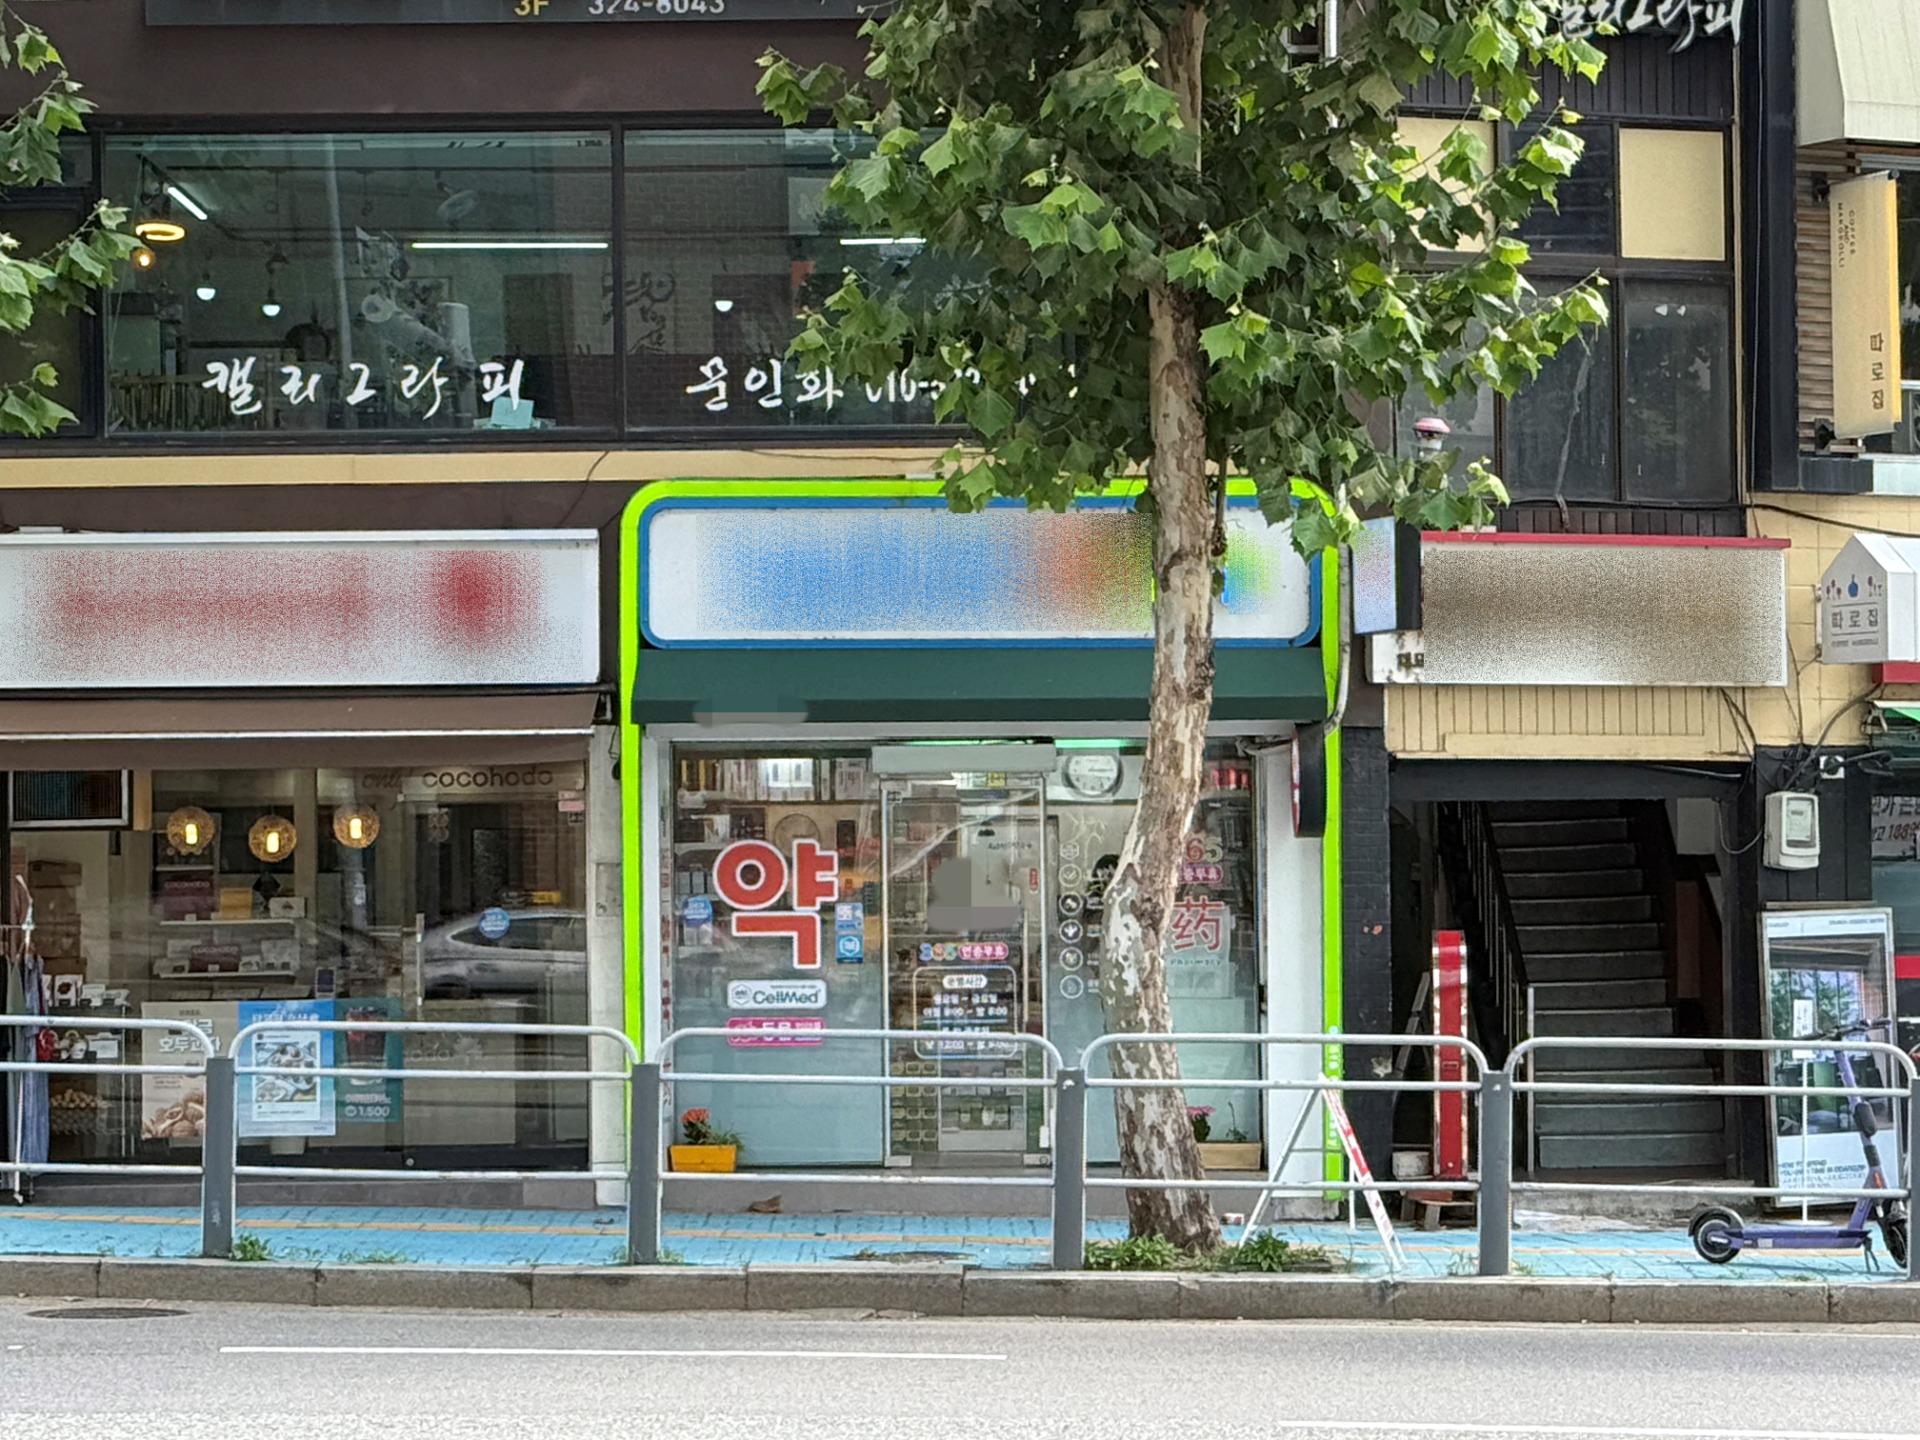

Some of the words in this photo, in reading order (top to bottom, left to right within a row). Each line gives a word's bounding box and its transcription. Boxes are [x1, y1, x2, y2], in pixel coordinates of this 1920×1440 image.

[514, 0, 549, 16] 3F
[202, 356, 524, 421] 캘리그라피
[422, 767, 553, 788] cocohodo
[712, 838, 839, 969] 약
[1171, 895, 1225, 953] 药
[752, 990, 819, 1004] CellMed
